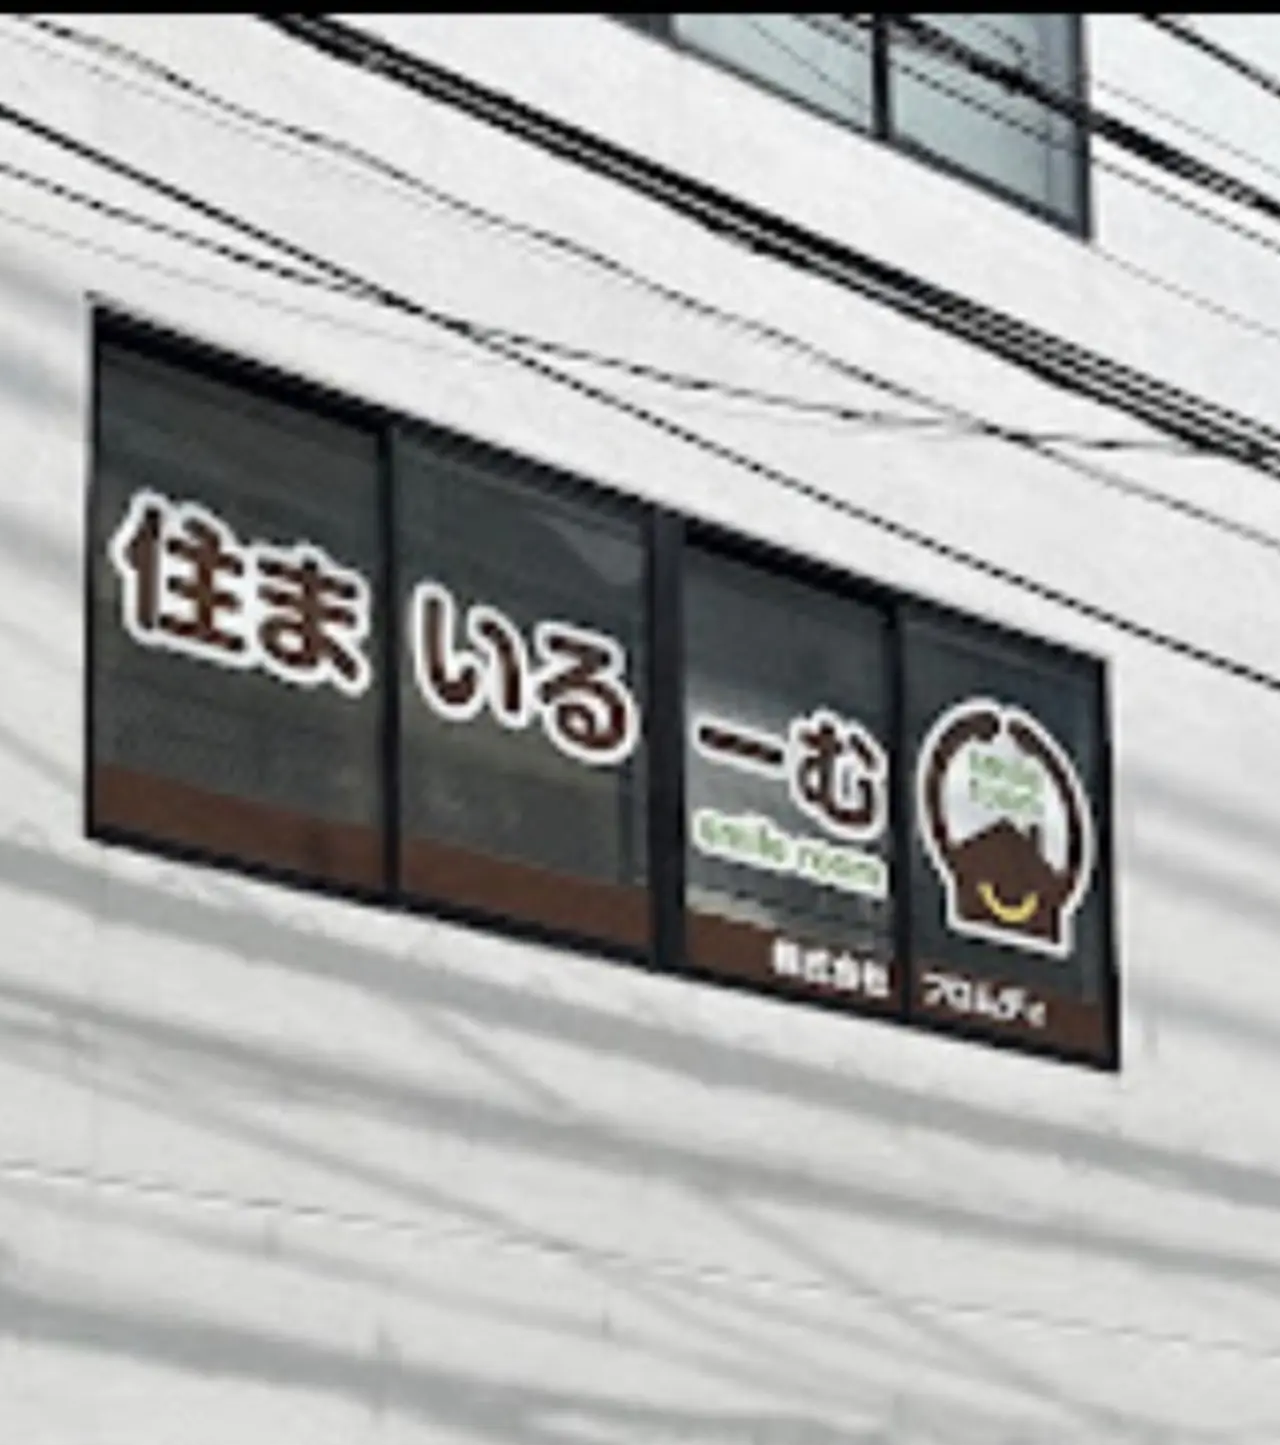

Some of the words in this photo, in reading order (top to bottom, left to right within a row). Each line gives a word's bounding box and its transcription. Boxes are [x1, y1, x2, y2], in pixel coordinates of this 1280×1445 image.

[110, 490, 886, 838] 住まいるーむ
